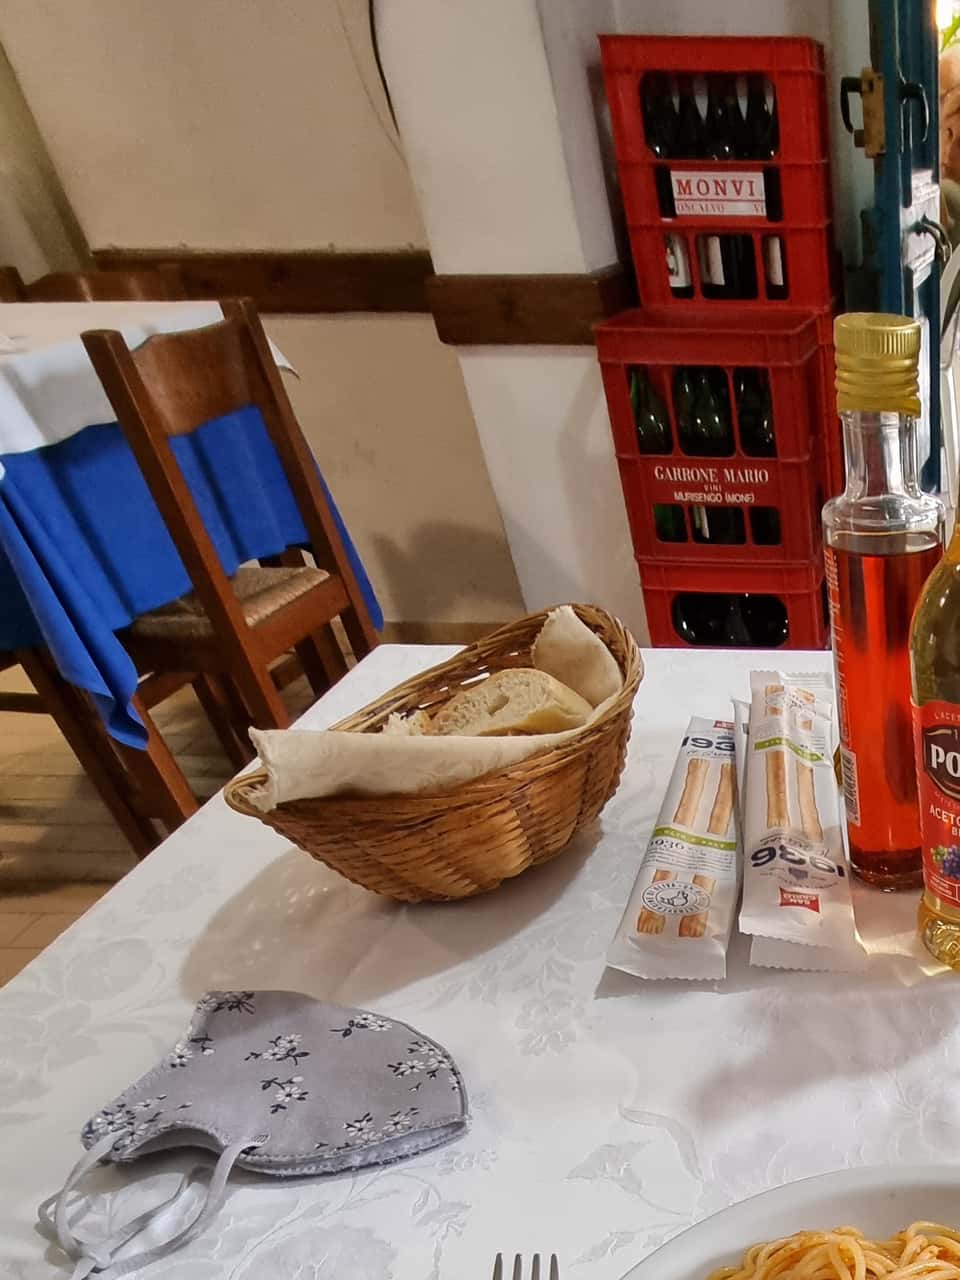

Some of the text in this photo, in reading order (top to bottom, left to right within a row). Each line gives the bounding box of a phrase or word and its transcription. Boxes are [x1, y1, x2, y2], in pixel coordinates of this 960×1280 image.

[675, 178, 755, 197] MONVI
[723, 468, 769, 483] MARIO
[681, 736, 736, 752] 193
